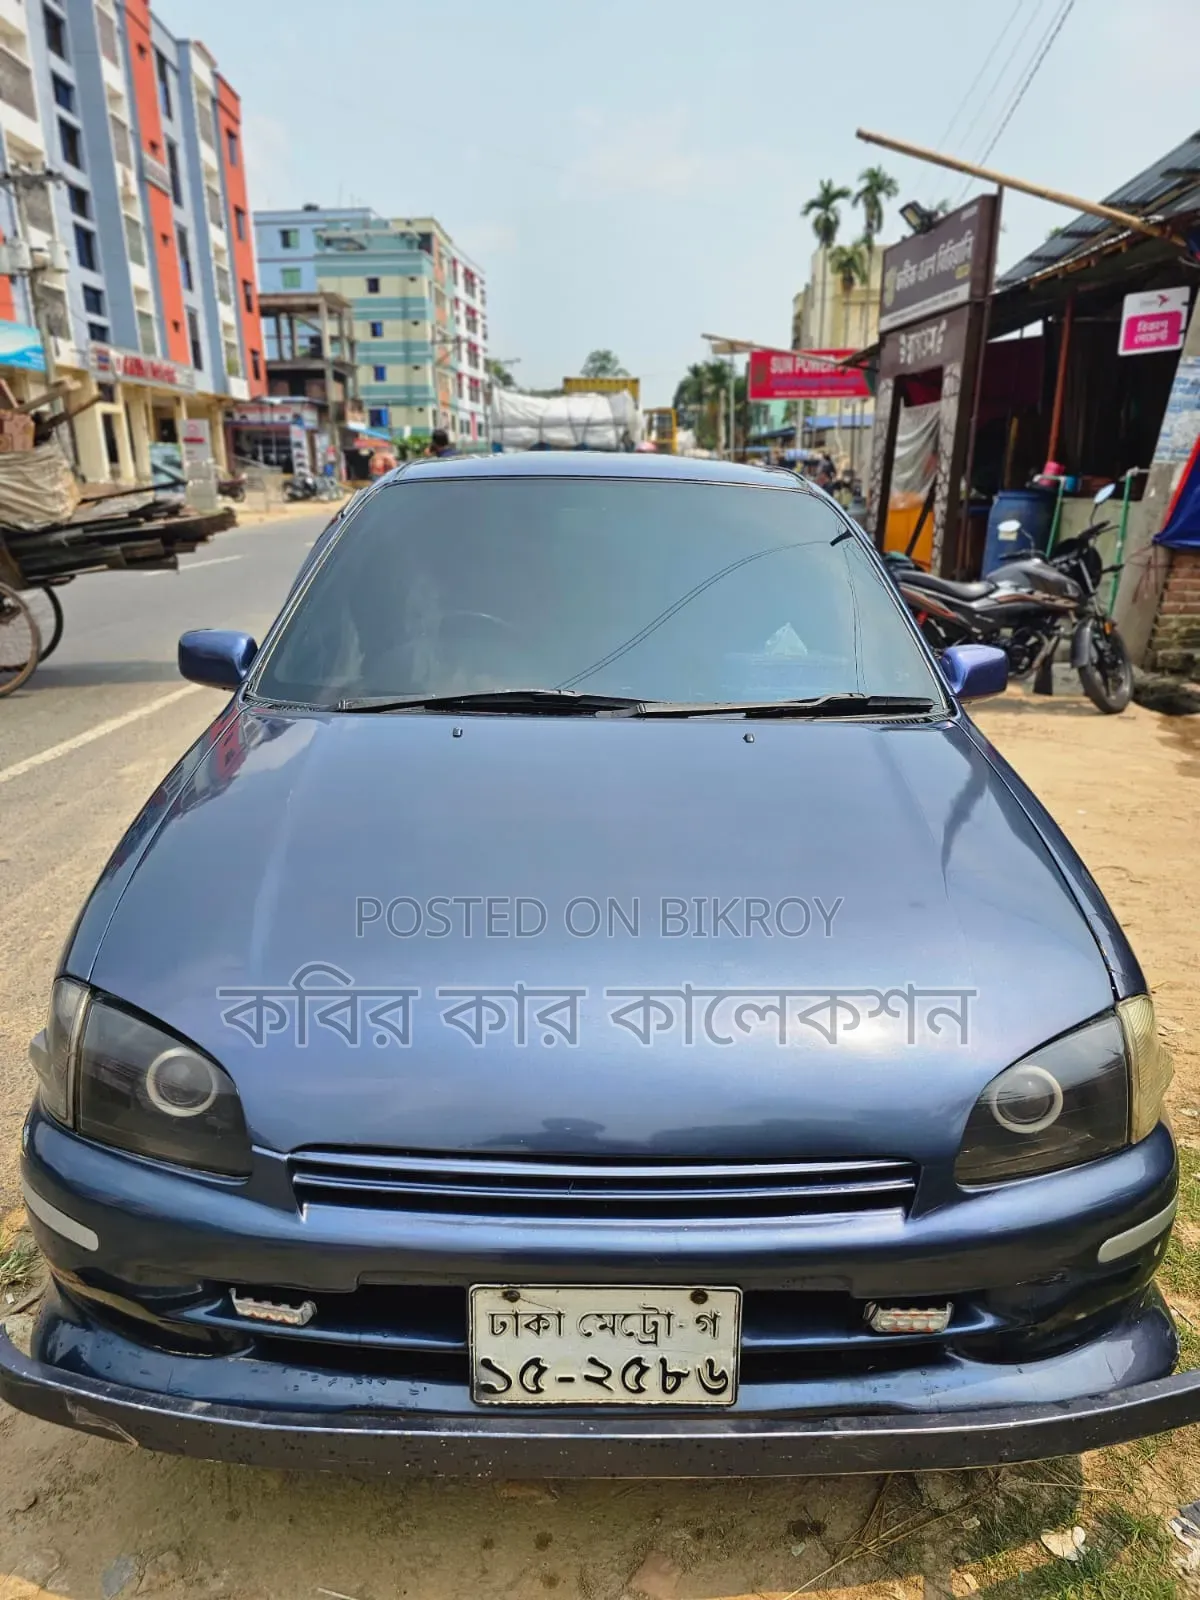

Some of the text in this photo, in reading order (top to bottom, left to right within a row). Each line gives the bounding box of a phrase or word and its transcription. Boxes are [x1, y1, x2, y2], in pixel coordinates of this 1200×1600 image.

[770, 356, 793, 374] SUN
[487, 1308, 564, 1337] ঢাকা
[480, 1355, 730, 1396] ১৫-২৫৮৬
